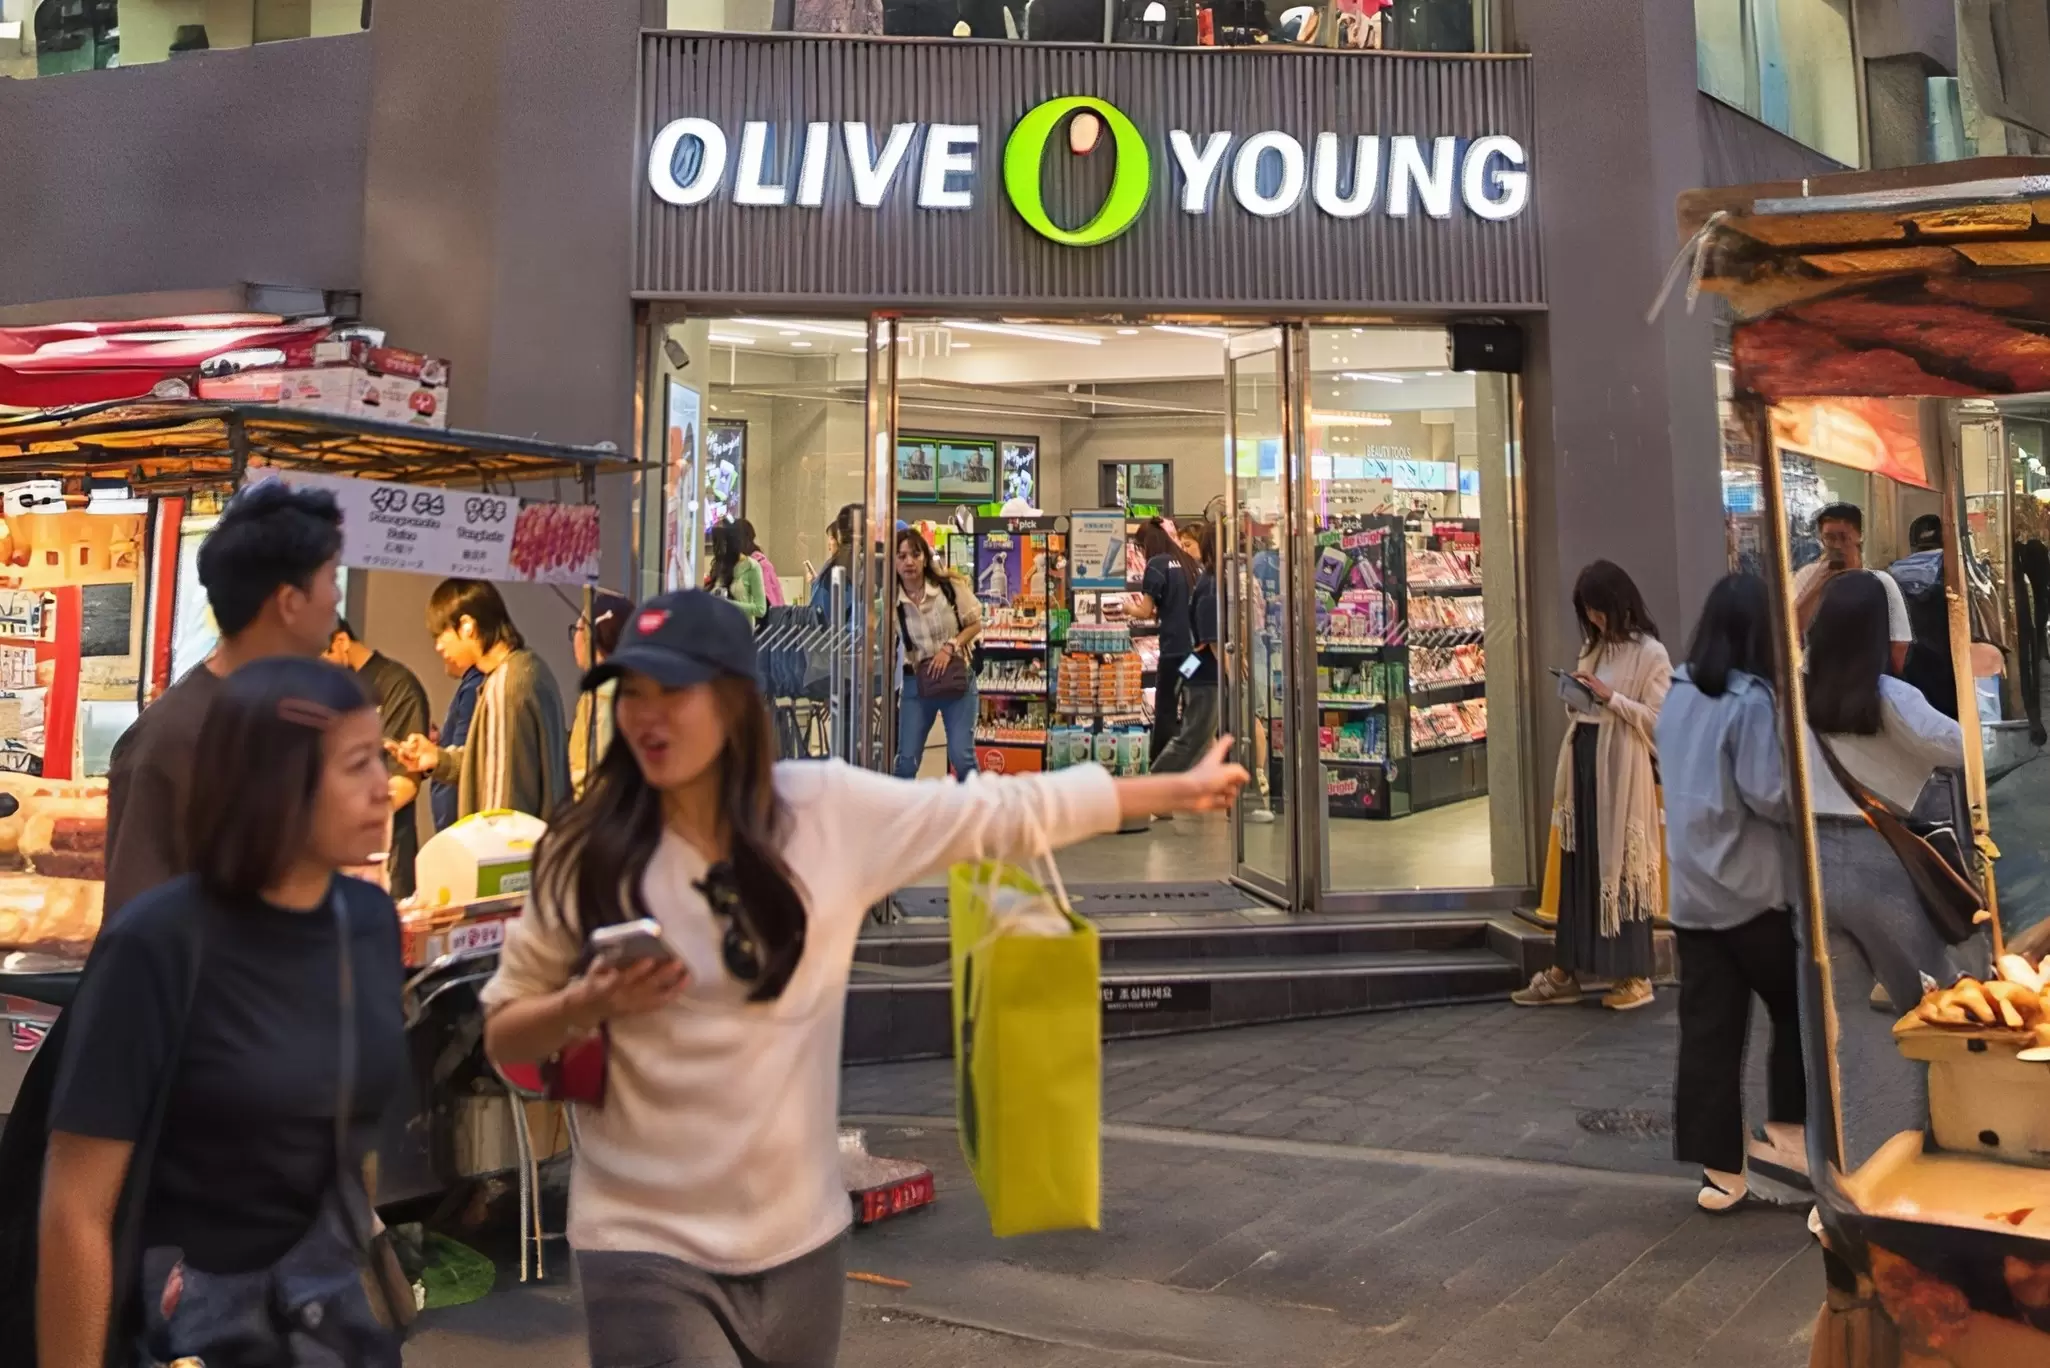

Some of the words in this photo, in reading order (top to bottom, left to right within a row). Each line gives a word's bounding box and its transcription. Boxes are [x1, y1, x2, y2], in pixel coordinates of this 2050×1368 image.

[648, 116, 979, 209] OLIVE
[1169, 129, 1529, 221] YOUNG
[1366, 444, 1390, 458] BEAUTY
[1391, 446, 1413, 459] TOOLS
[1119, 986, 1172, 1000] 조심하세요
